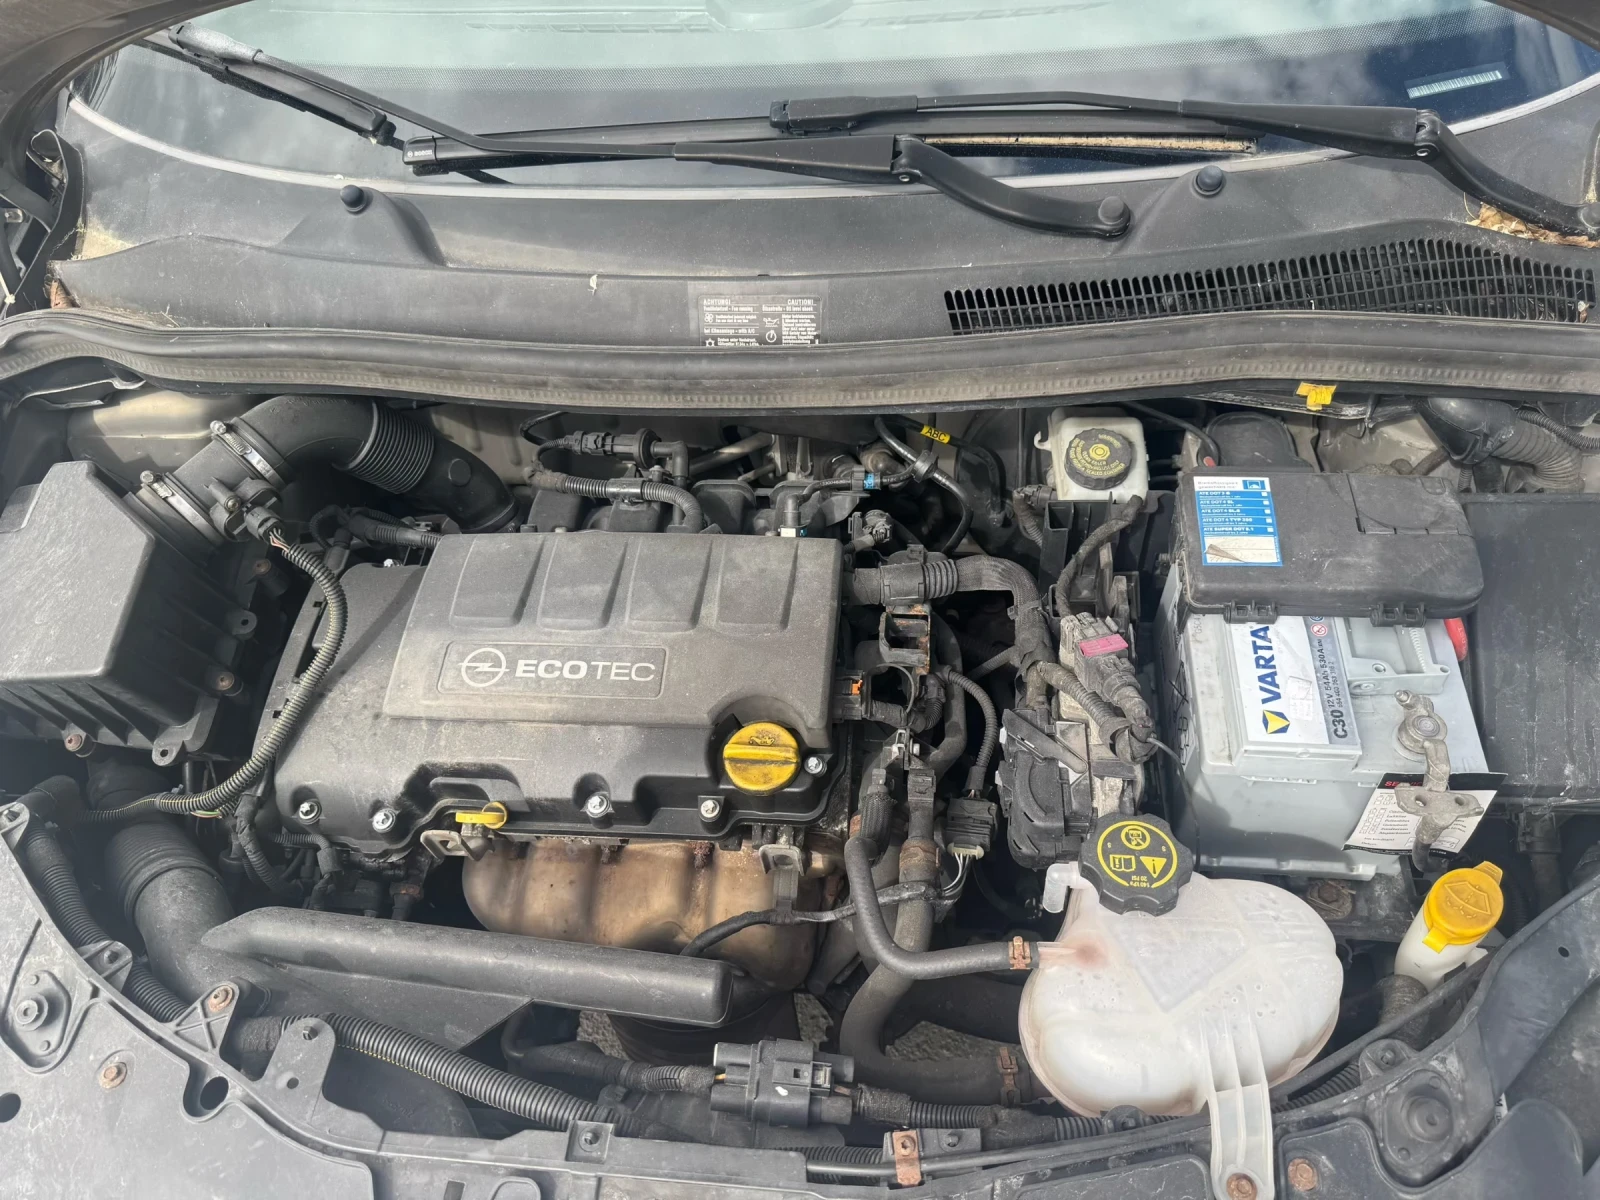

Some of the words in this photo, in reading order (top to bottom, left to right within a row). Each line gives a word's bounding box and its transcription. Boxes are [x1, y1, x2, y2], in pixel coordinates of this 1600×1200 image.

[925, 428, 946, 441] ABC
[1250, 626, 1281, 704] VARTA
[1317, 648, 1327, 668] 530A
[515, 660, 655, 681] ECOTEC
[1321, 670, 1331, 691] 54Ah
[1325, 694, 1335, 708] 12V
[1330, 709, 1348, 739] C30
